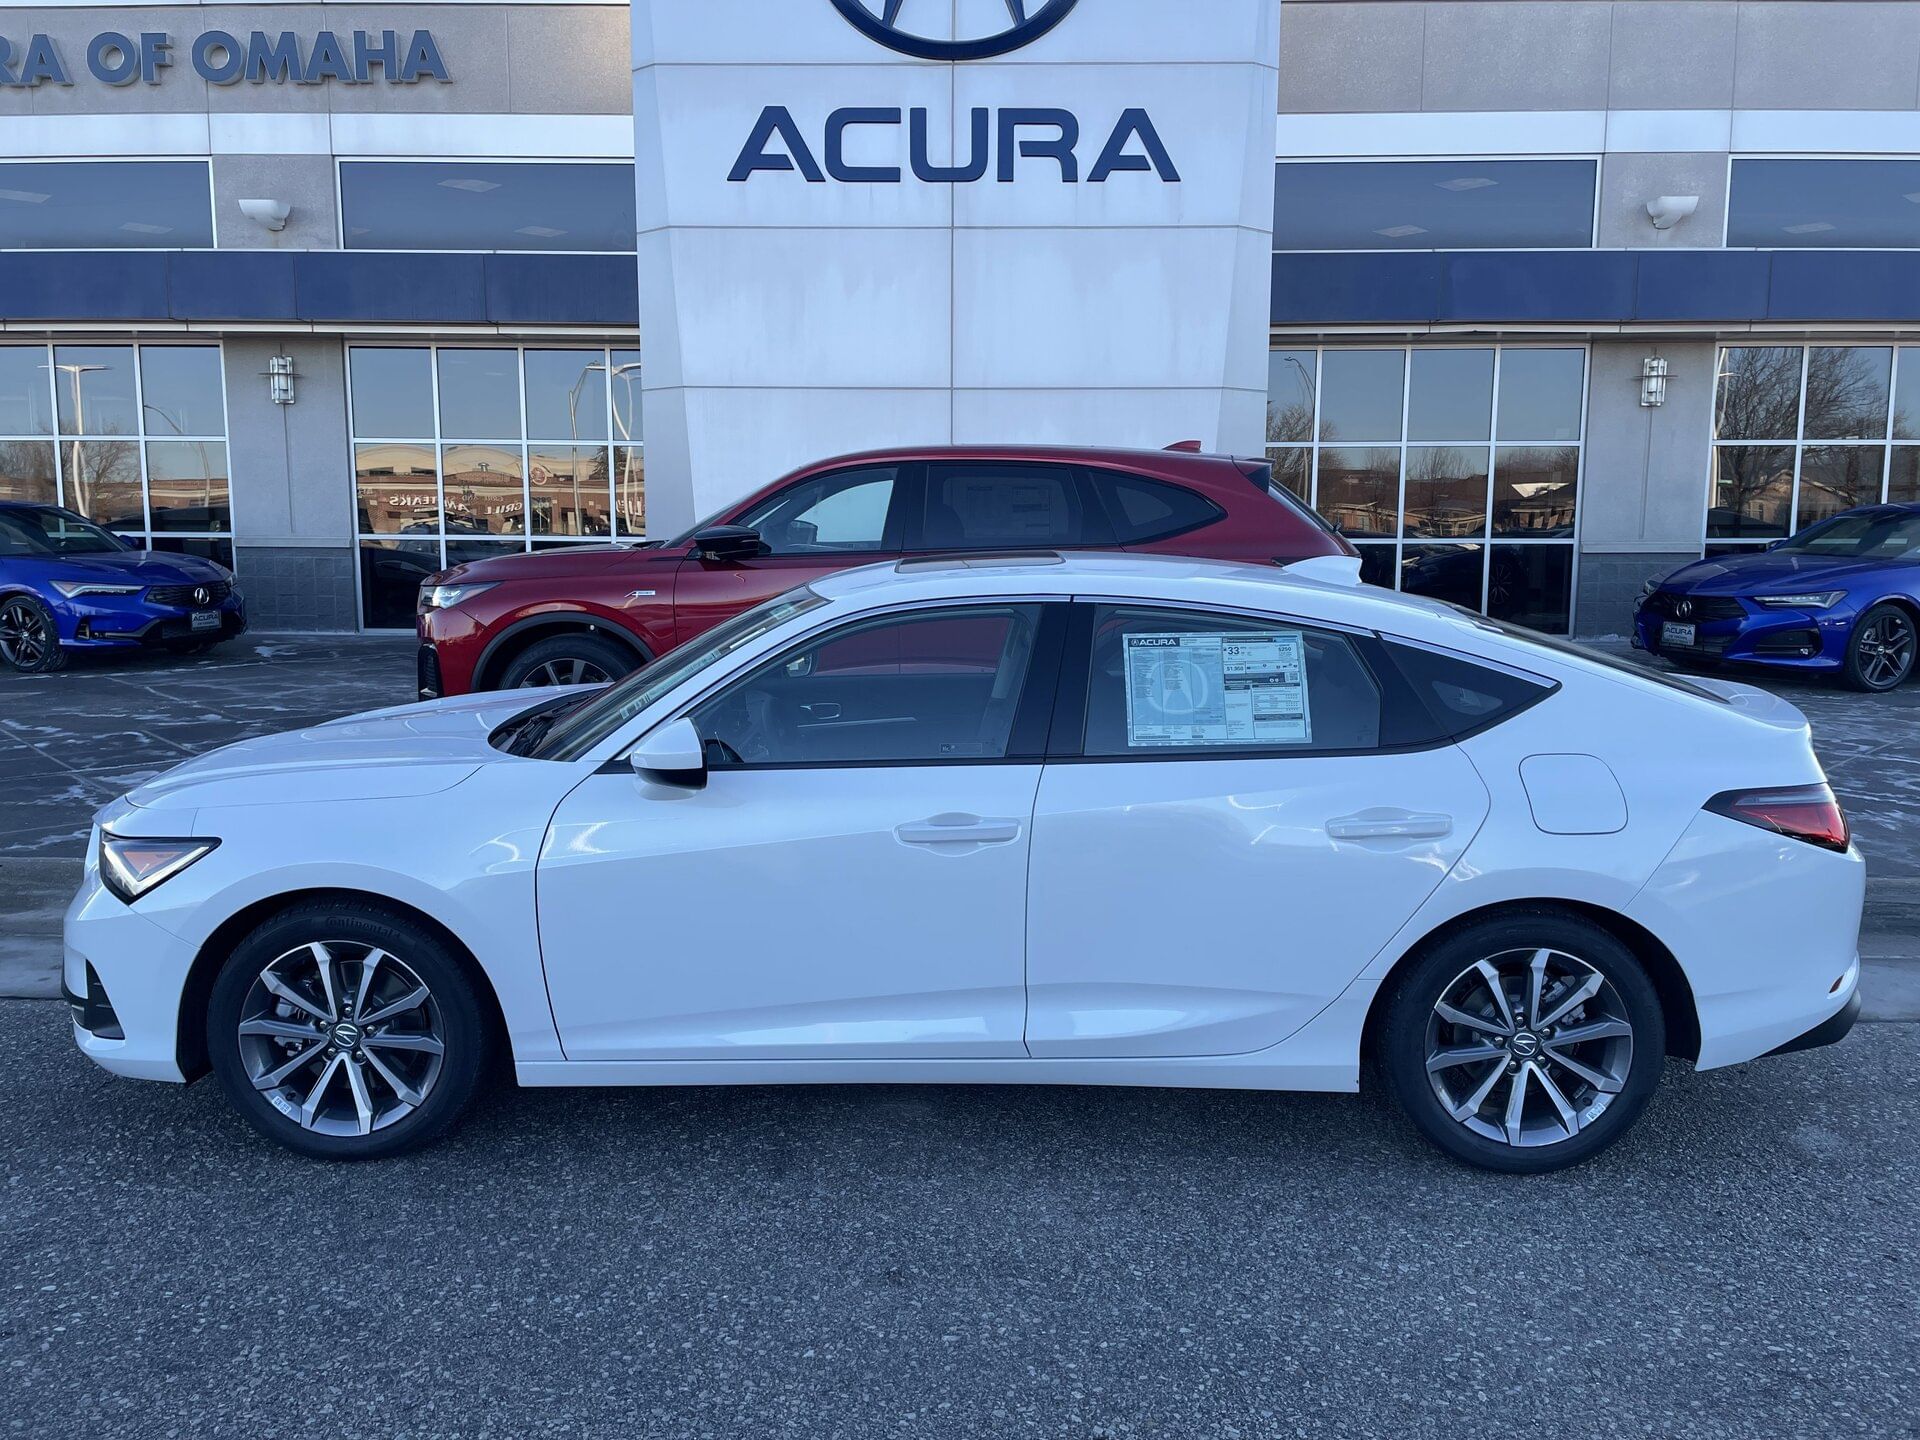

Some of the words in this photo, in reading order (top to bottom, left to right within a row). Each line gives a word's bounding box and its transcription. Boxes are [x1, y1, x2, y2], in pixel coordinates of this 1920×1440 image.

[86, 31, 173, 85] OF
[191, 29, 453, 85] OMAHA
[726, 105, 1182, 183] ACURA
[1139, 639, 1176, 647] ACURA
[1227, 646, 1240, 655] 33
